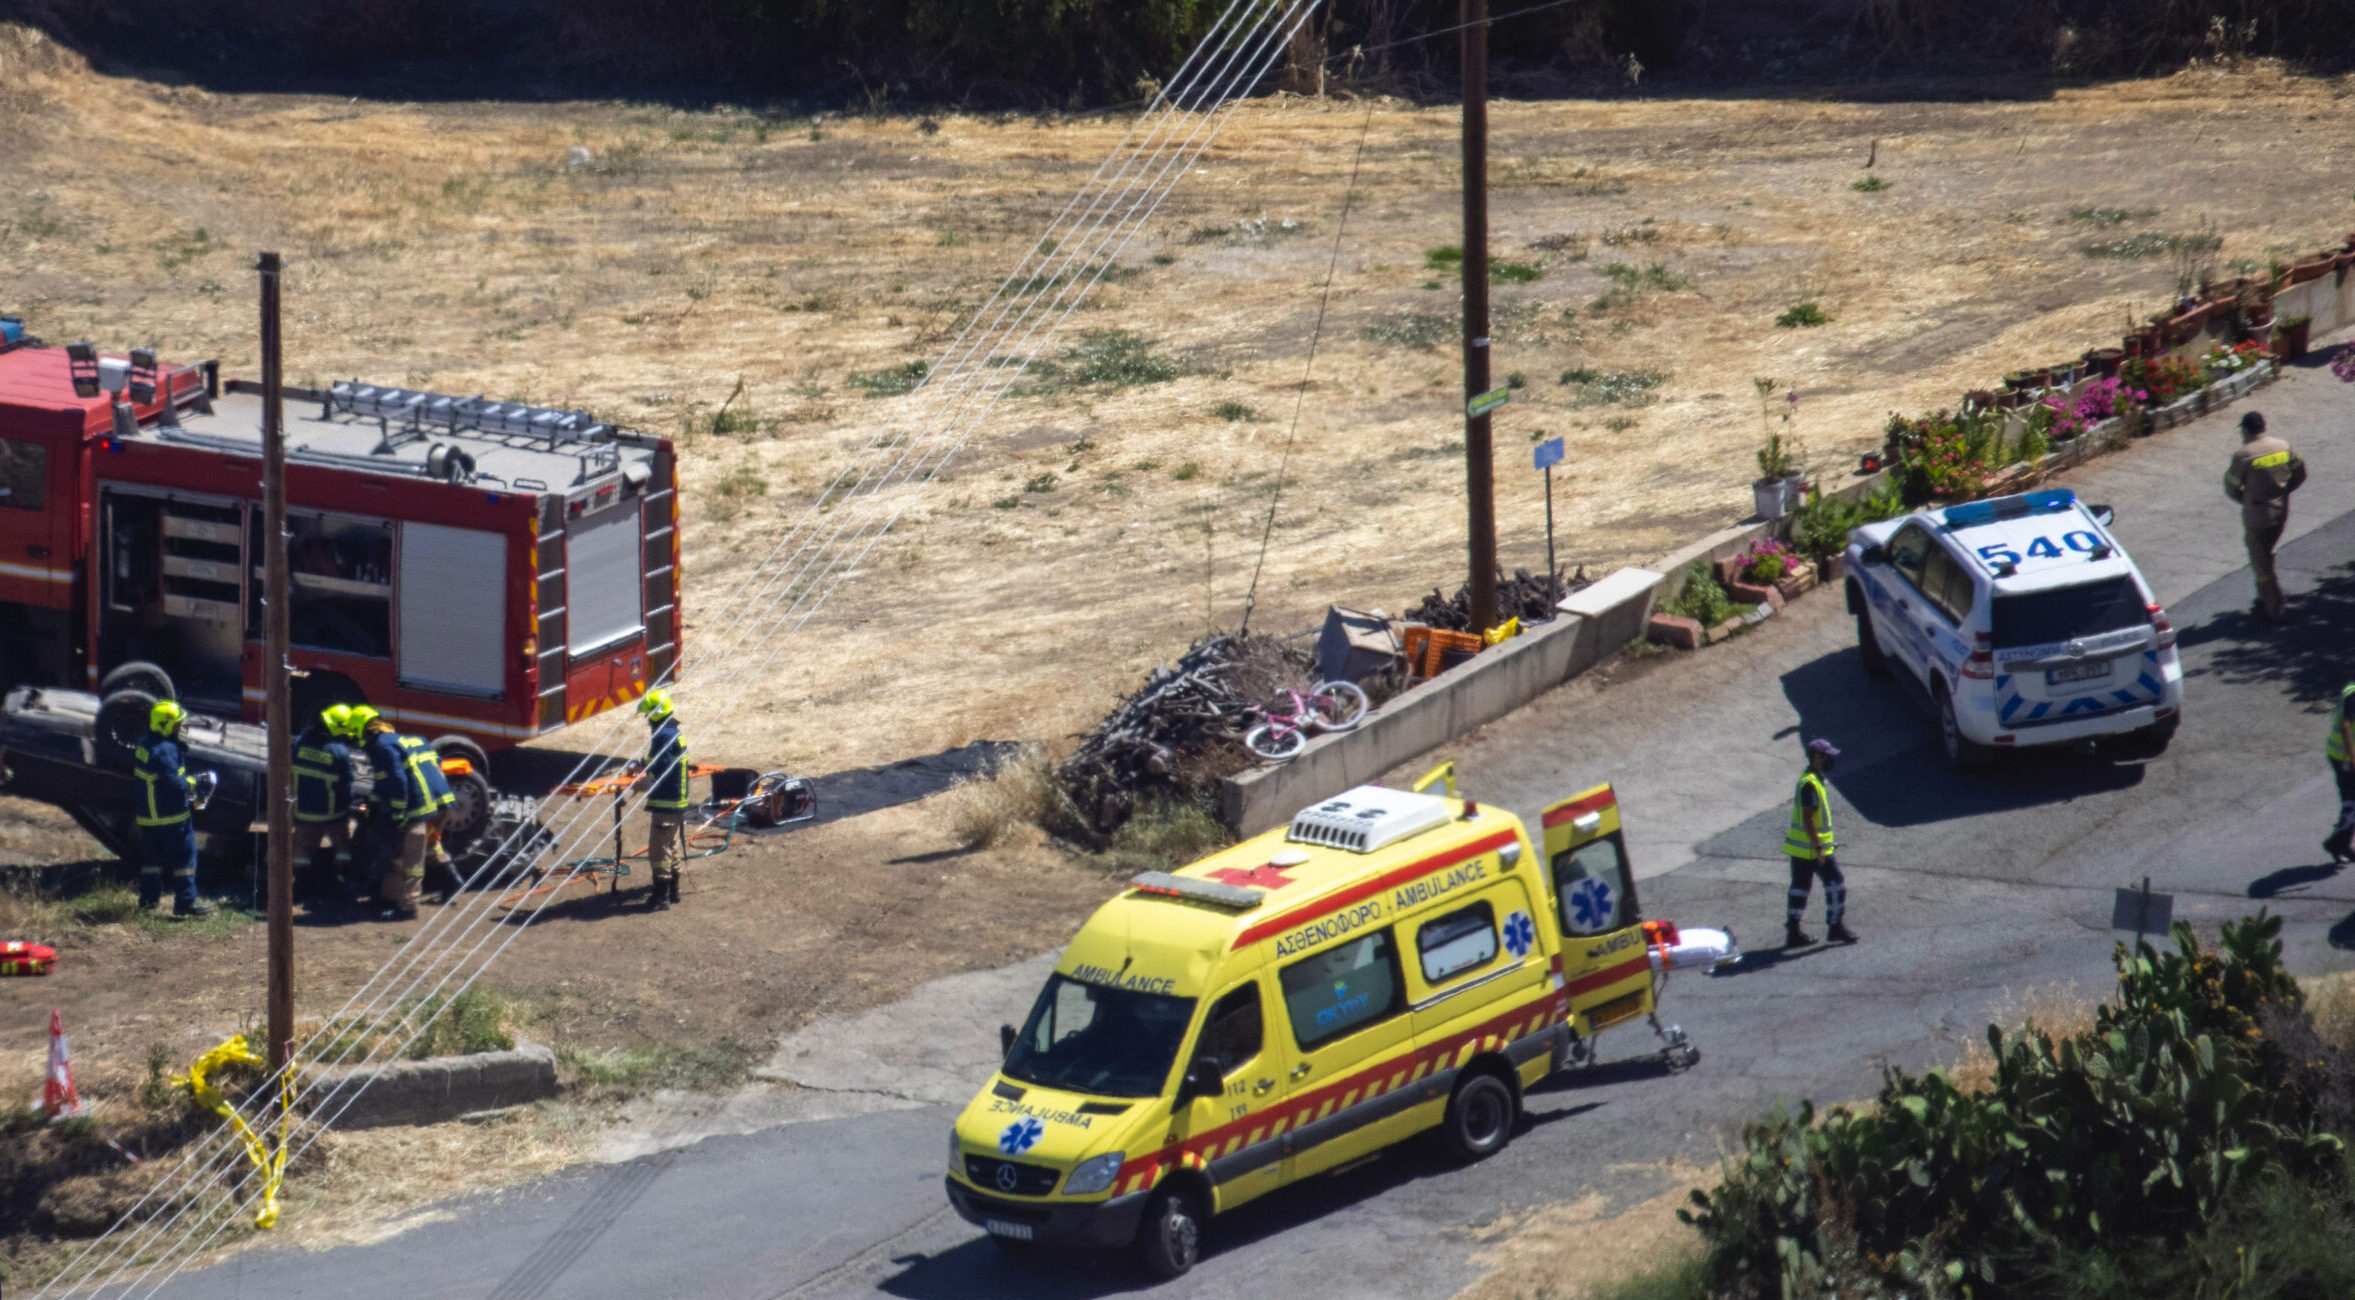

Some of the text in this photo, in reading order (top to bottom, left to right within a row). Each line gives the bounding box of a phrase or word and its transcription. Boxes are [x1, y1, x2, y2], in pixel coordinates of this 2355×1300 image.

[1977, 530, 2104, 569] 540
[1276, 860, 1488, 959] ΑΣΘΕΝΟΦΟΡΟ AMBULANCE
[1226, 1080, 1246, 1097] 112
